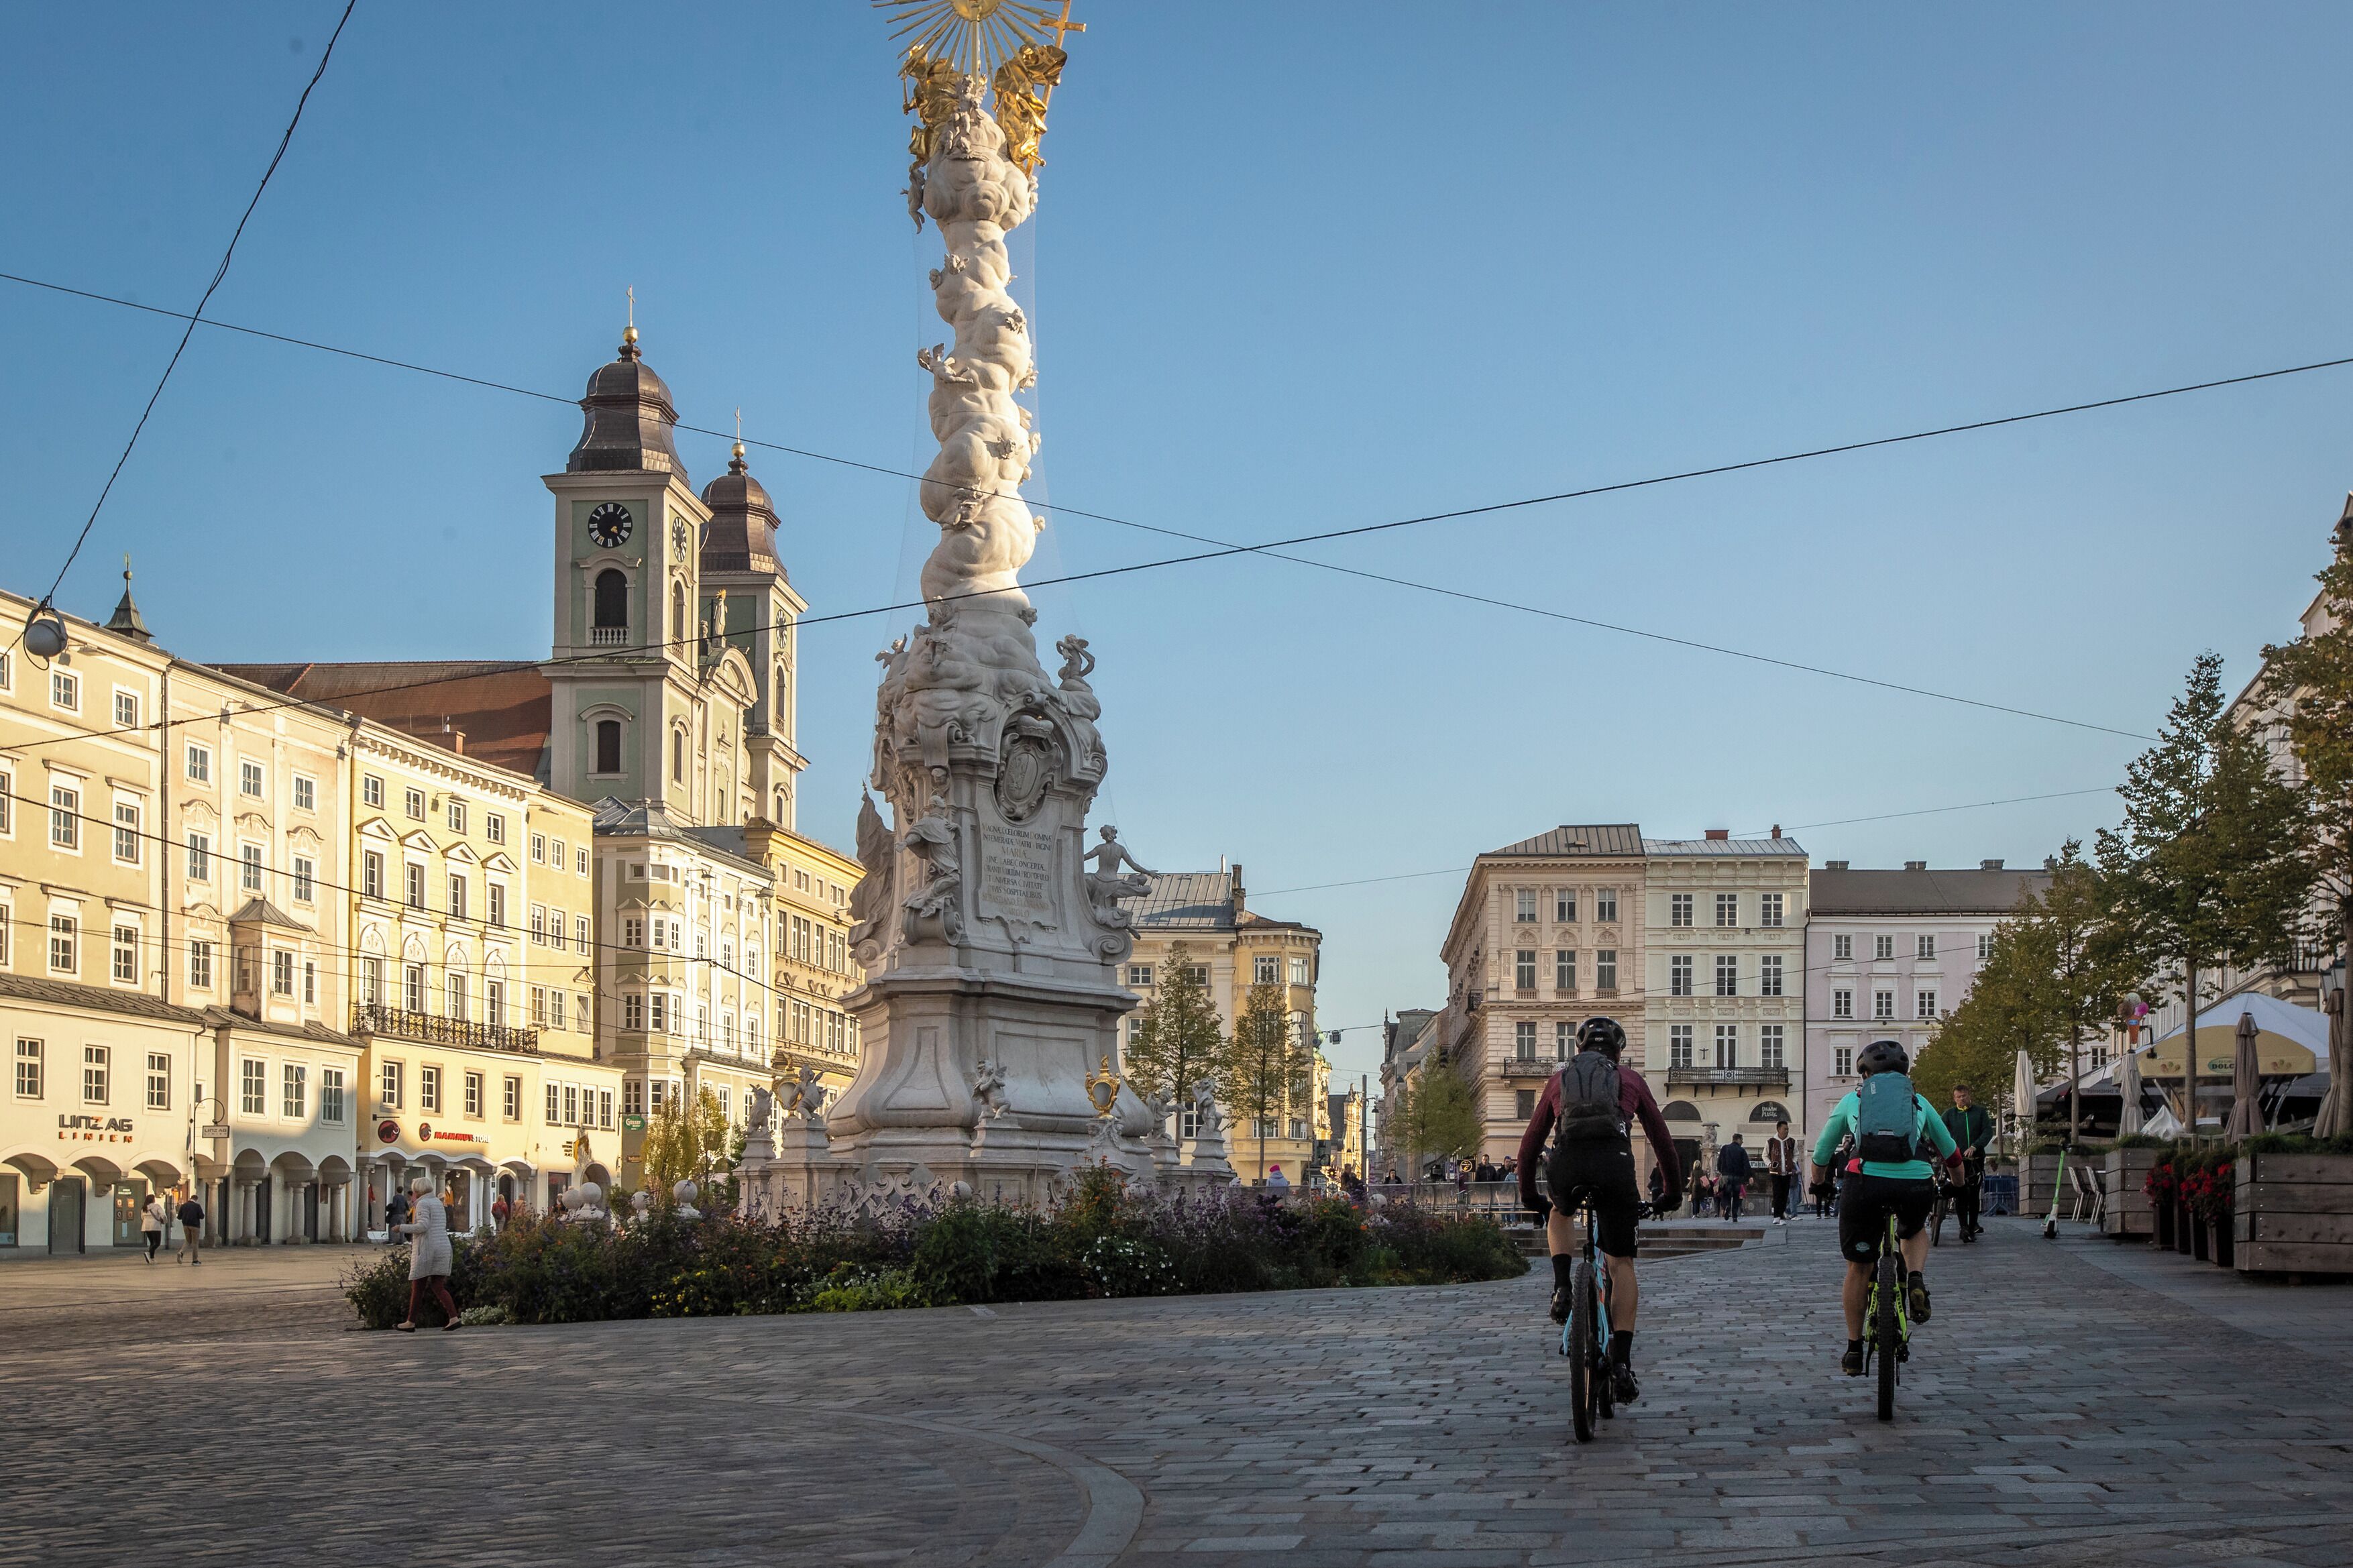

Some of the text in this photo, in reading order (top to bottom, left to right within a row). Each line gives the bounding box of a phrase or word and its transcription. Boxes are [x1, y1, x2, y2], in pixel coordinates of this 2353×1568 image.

[59, 1114, 133, 1132] LINZ AG
[58, 1131, 133, 1143] LINIEN
